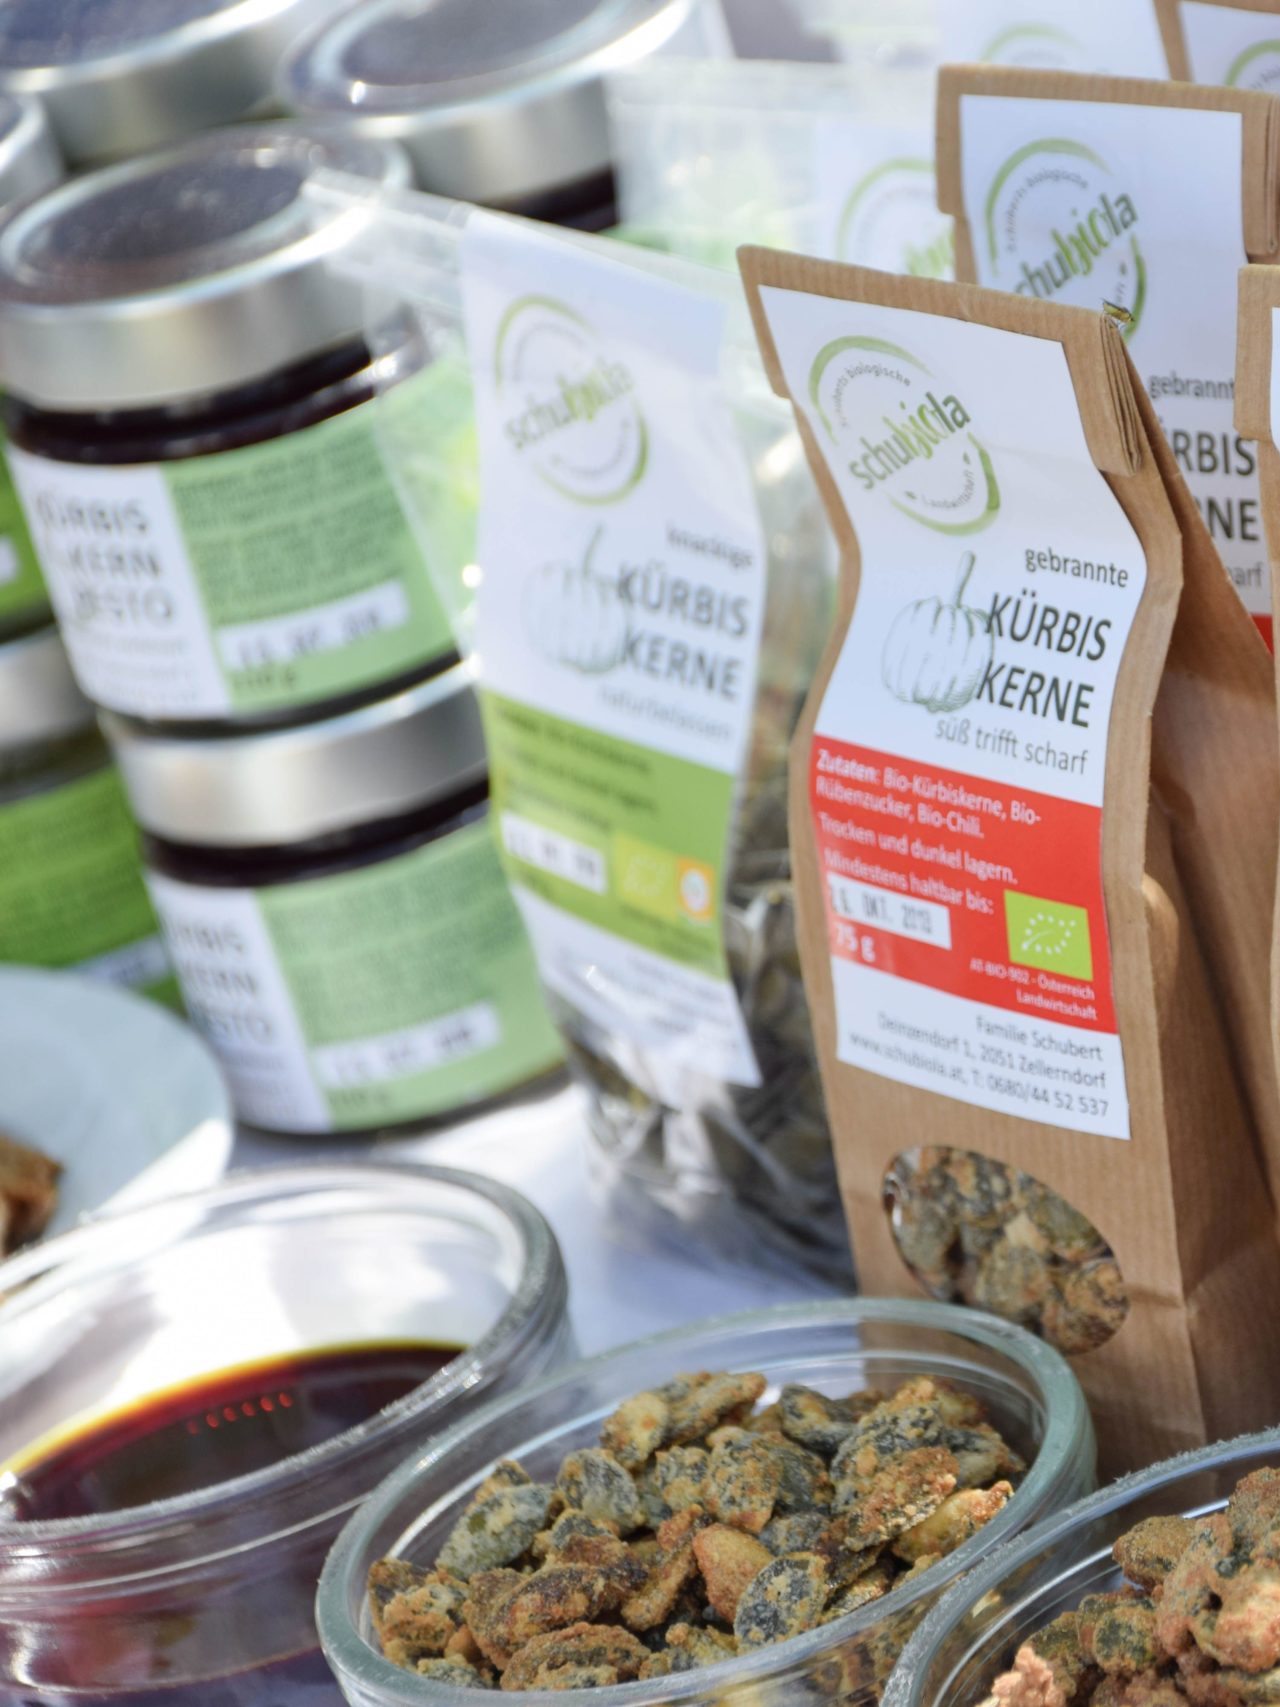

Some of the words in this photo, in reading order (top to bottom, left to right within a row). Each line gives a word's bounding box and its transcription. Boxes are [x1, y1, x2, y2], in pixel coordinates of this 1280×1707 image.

[1014, 192, 1138, 298] hubiola
[1149, 371, 1236, 400] gebrannt
[849, 391, 971, 490] schubiola
[1160, 418, 1256, 476] RBIS
[1025, 546, 1128, 588] gebrannte
[985, 588, 1112, 661] KÜRBIS
[977, 659, 1095, 728] KERNE
[936, 714, 972, 746] süß
[975, 726, 1018, 759] trifft
[1024, 740, 1089, 776] scharf
[1011, 800, 1040, 824] Bio-
[977, 1015, 1027, 1045] Familie
[1032, 1031, 1104, 1062] Schubert
[1019, 1052, 1106, 1090] Zellerndorf
[1054, 1092, 1074, 1111] 52
[1079, 1096, 1109, 1117] 537
